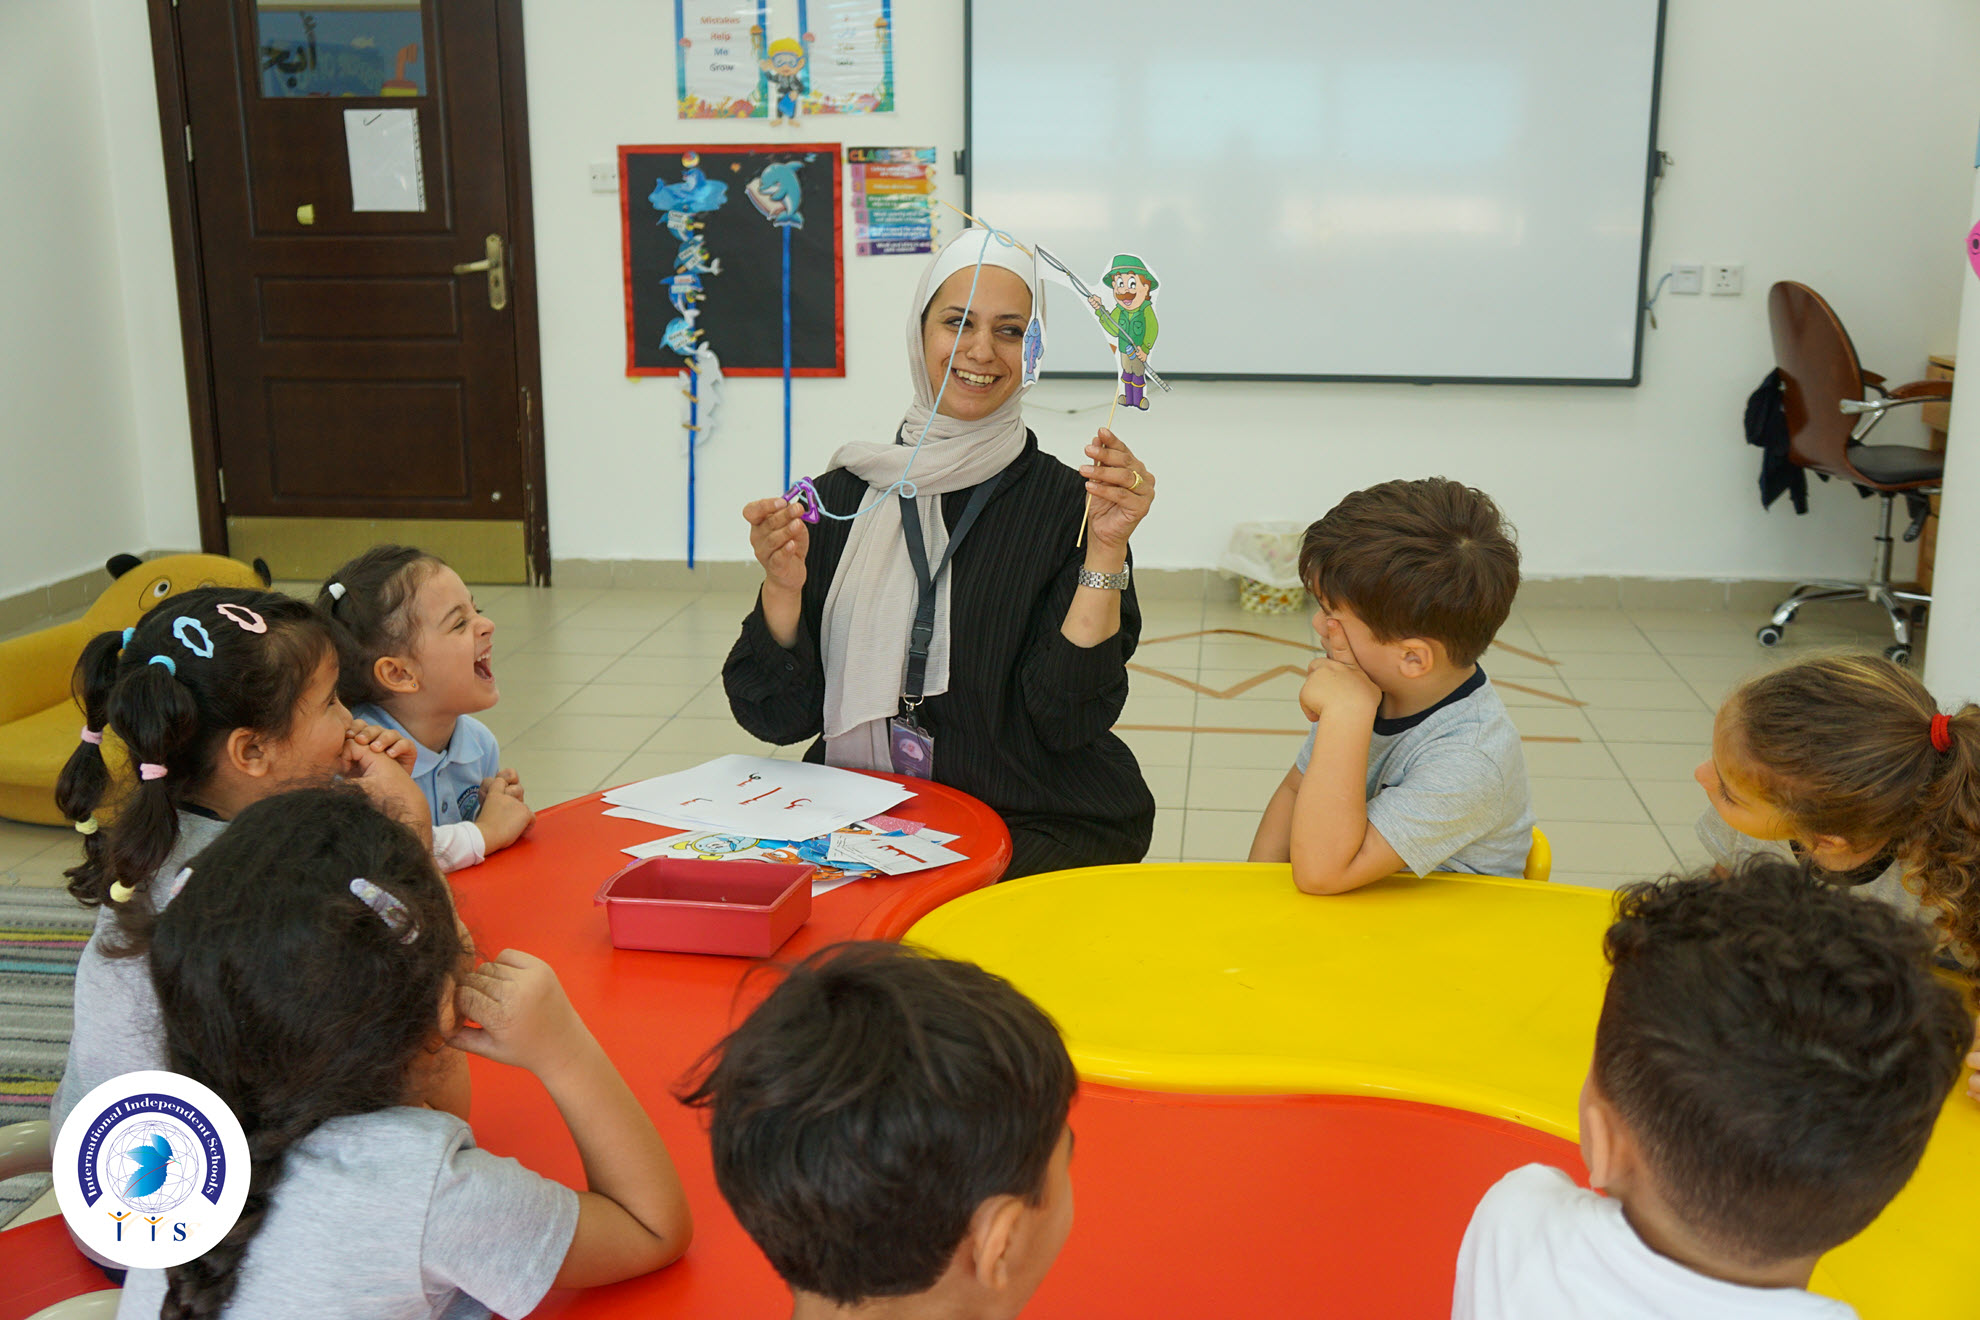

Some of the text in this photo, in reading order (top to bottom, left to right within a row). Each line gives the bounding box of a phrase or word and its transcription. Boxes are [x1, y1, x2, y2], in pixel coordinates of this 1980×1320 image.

[700, 16, 740, 24] Mistakes
[711, 32, 731, 41] Help
[714, 47, 728, 56] Me
[710, 62, 734, 71] Grow
